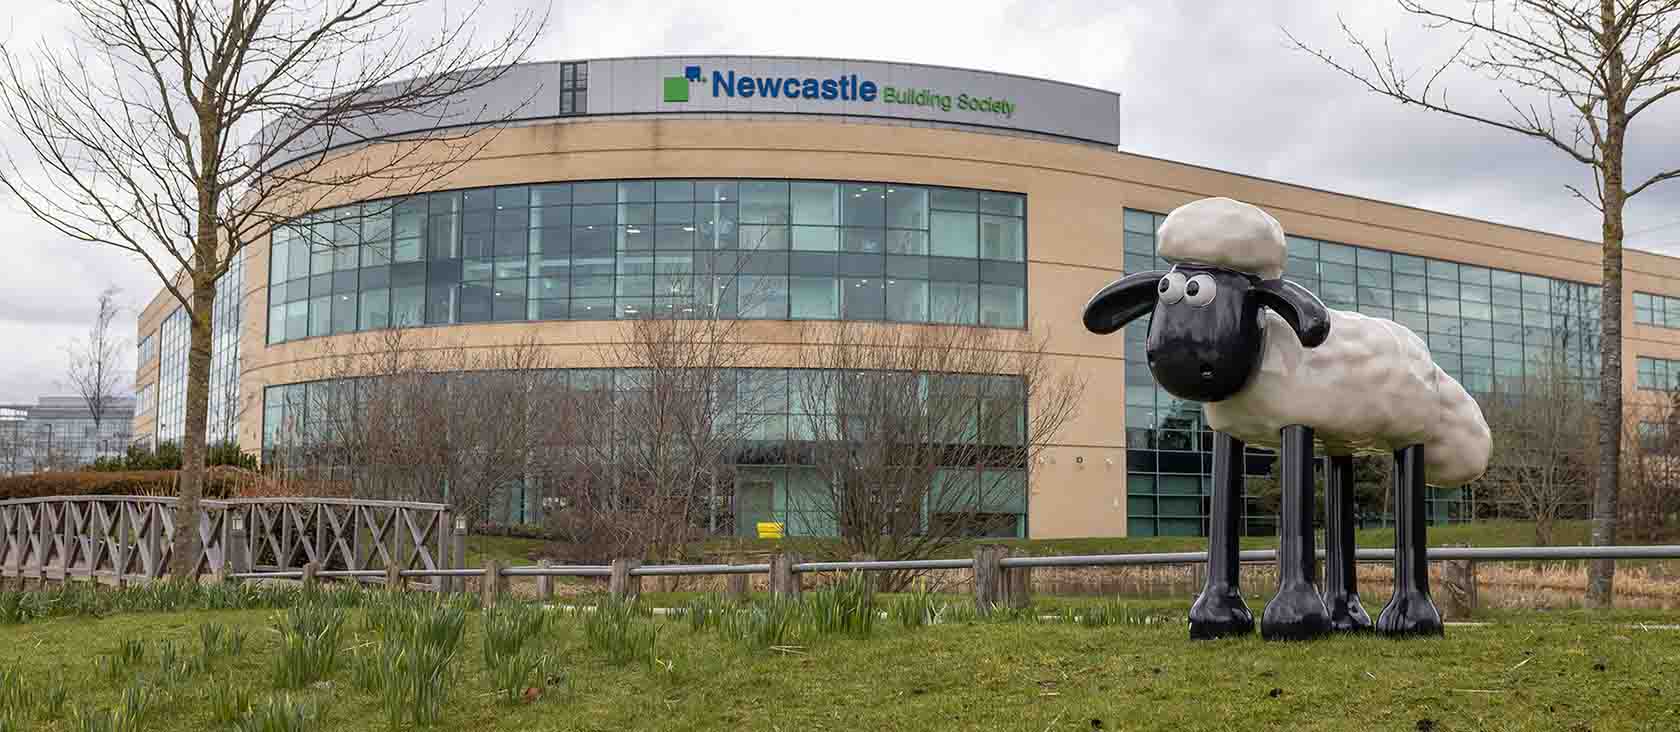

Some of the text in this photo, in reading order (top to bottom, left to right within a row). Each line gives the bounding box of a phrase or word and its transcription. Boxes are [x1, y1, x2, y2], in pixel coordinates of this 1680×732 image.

[711, 70, 1015, 117] Newcastle Building Society
